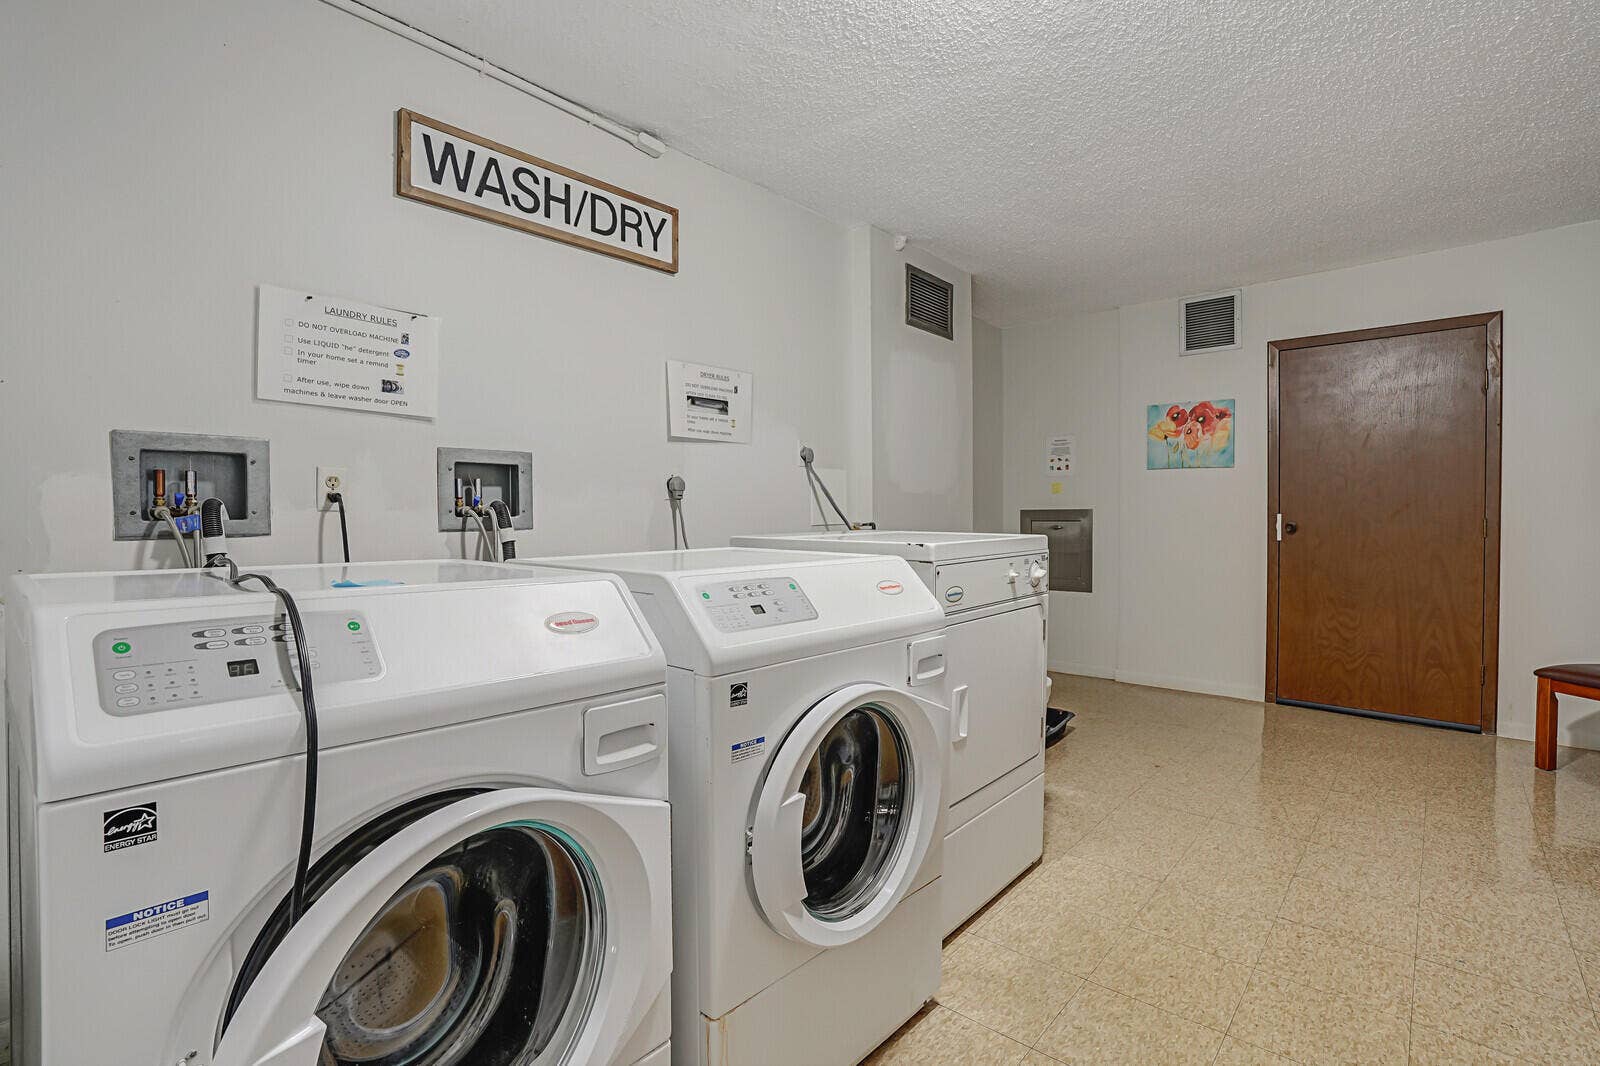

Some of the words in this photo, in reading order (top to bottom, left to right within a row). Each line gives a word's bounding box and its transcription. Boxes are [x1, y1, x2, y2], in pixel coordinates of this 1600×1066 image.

[422, 133, 667, 252] WASH/DRY
[325, 306, 367, 319] LAUNDRY
[370, 315, 398, 326] RULES
[312, 323, 328, 331] NOT
[330, 327, 368, 337] OVERLOAD
[369, 334, 399, 343] MACHINE
[314, 340, 340, 349] LIQUID
[358, 347, 389, 357] detergent
[283, 388, 318, 396] machines
[104, 838, 136, 851] ENERGY
[137, 834, 157, 844] STAR
[133, 899, 185, 921] NOTICE
[108, 926, 127, 936] DOOR
[128, 921, 146, 930] LOCK
[147, 915, 165, 924] LIGHT
[129, 923, 160, 936] attempting
